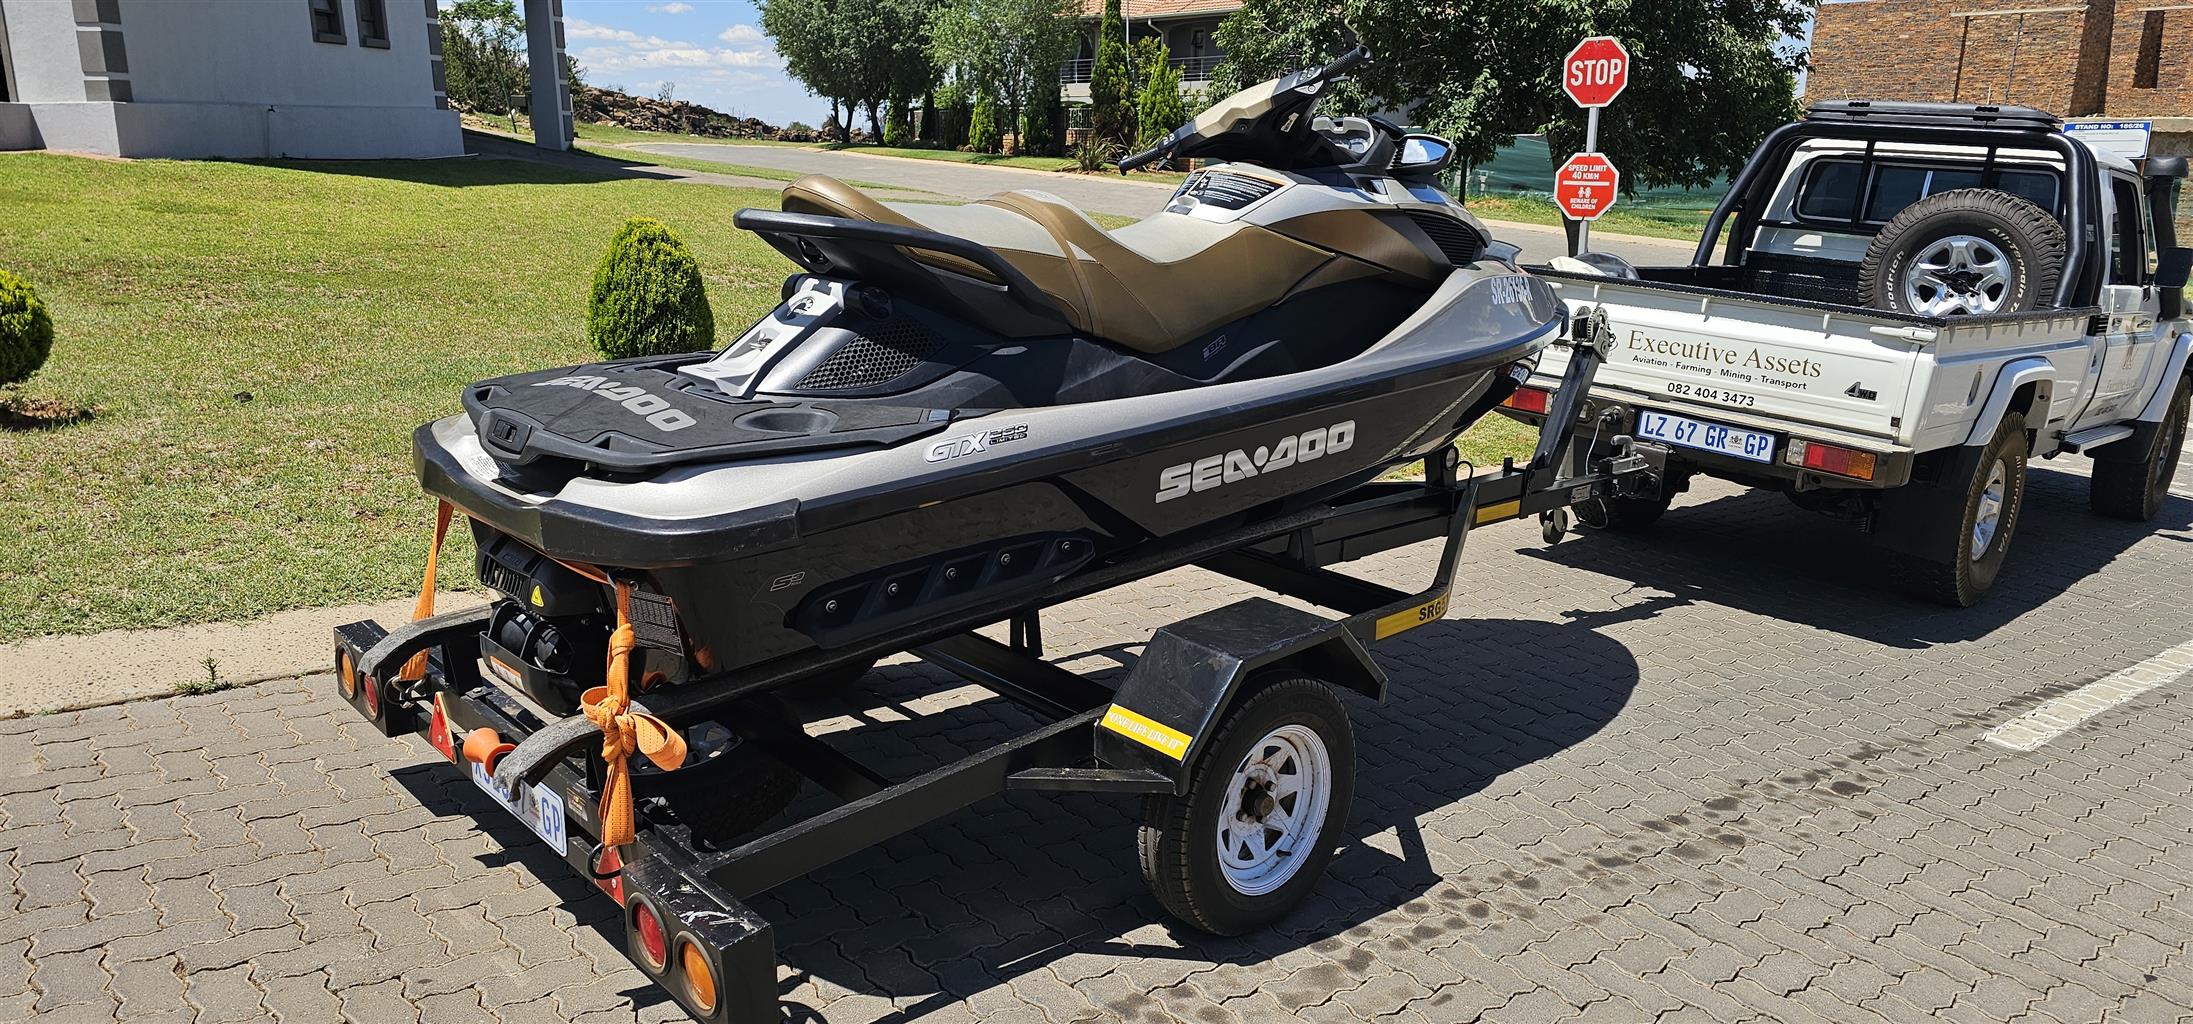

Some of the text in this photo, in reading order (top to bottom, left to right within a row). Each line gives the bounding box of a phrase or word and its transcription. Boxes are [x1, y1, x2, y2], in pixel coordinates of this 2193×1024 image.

[1570, 58, 1622, 87] STOP
[1568, 164, 1588, 172] SPEED
[1572, 171, 1582, 180] 40
[1886, 250, 1905, 310] oodrich
[1627, 329, 1822, 378] Executive Assets
[1632, 354, 1808, 390] Aviation Farming Mining Transport
[1667, 382, 1755, 407] 082 404 3473
[1844, 381, 1878, 402] 4WD
[925, 431, 989, 463] GTX
[1643, 414, 1769, 457] LZ 67 GR GP
[541, 796, 561, 842] GP
